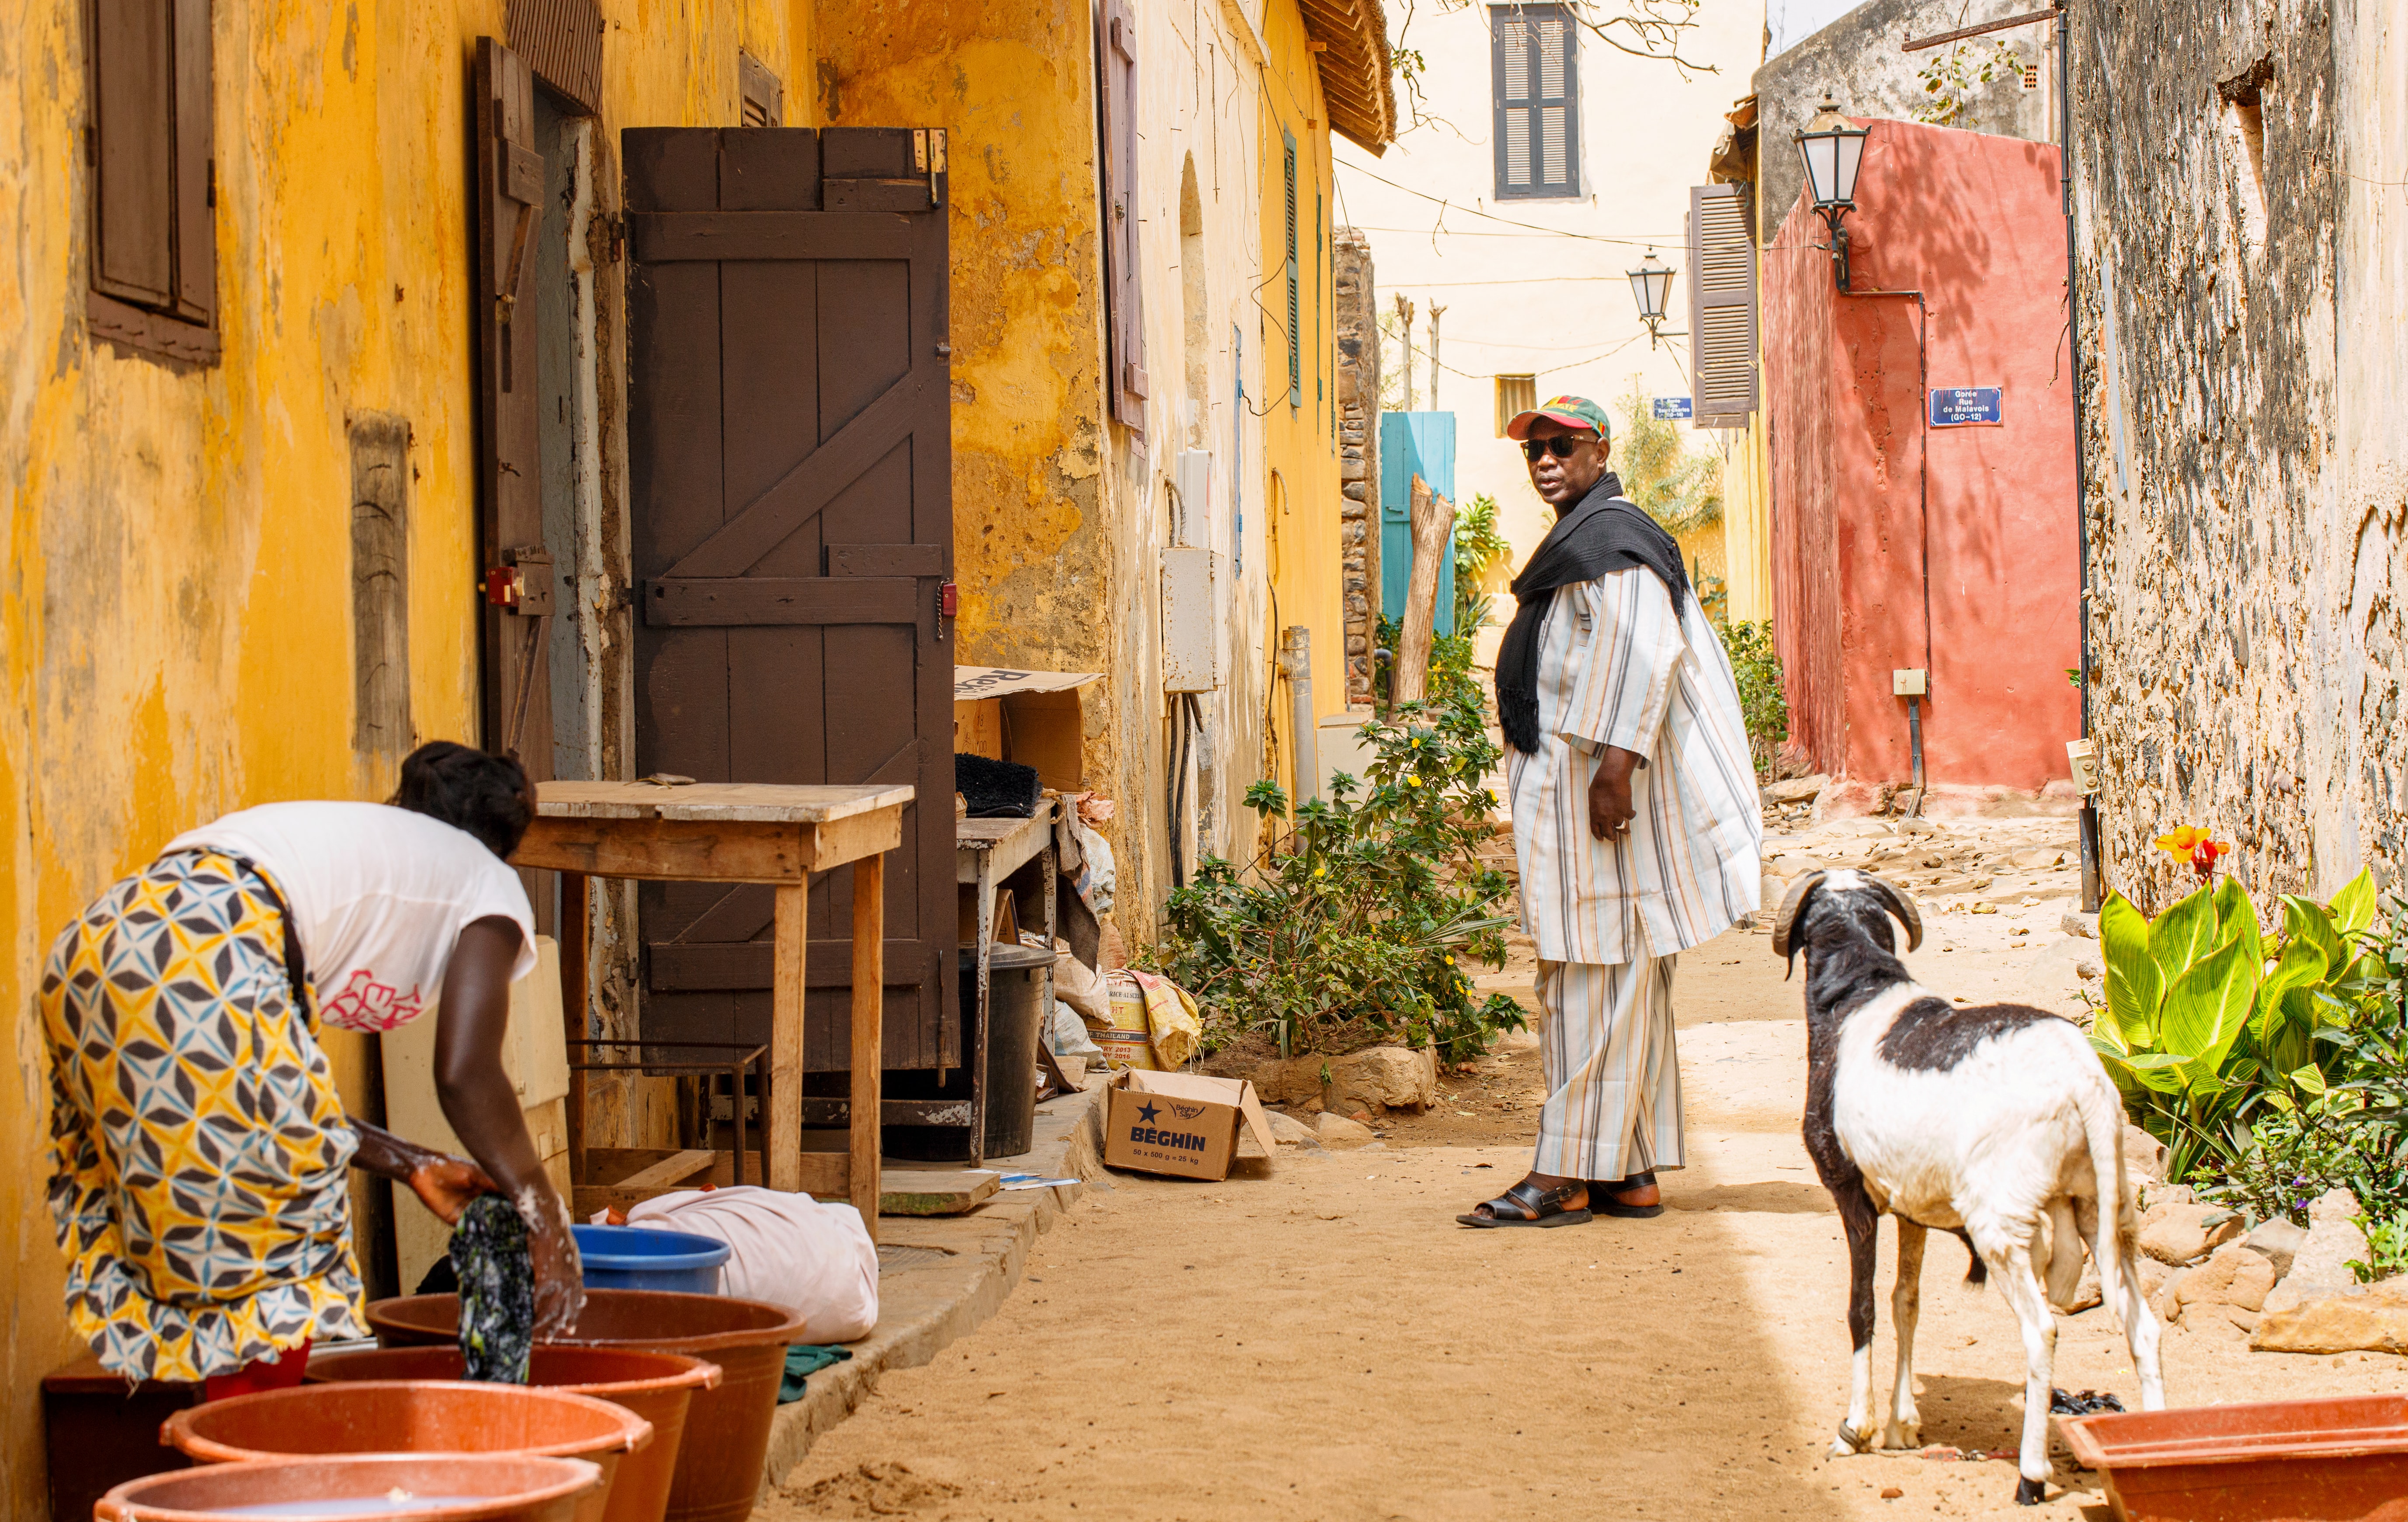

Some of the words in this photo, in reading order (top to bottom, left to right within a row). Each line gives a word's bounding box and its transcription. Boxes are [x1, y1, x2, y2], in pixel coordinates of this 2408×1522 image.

[1951, 413, 1982, 422] (GO-12)
[1176, 1104, 1198, 1113] Béghin
[1130, 1126, 1206, 1152] BÉGHIN
[1190, 1157, 1199, 1165] kg
